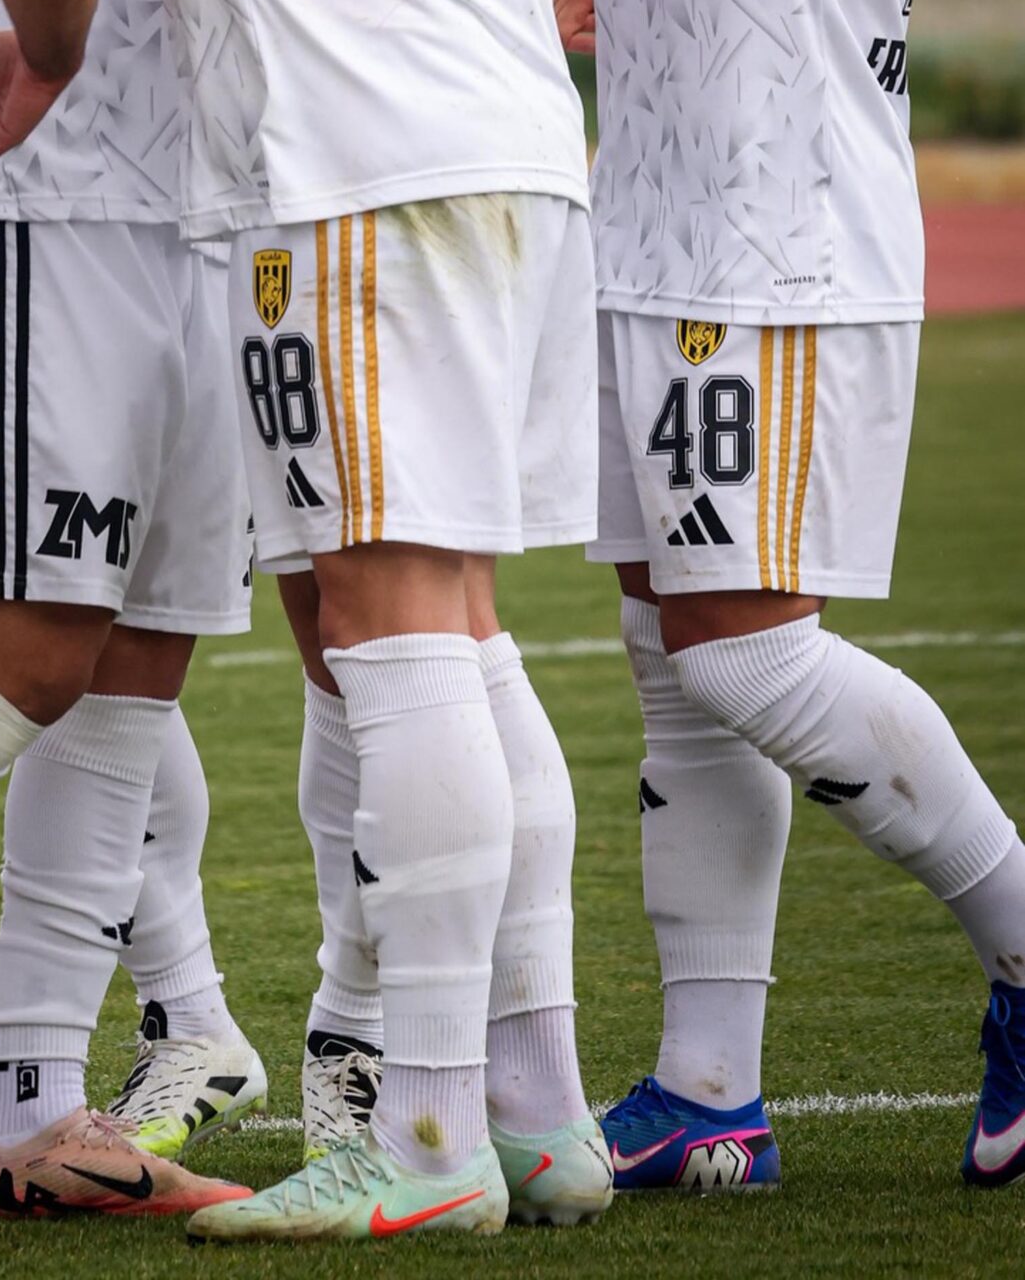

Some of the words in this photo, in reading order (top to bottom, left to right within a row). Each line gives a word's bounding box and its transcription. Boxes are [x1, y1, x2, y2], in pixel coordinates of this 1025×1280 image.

[240, 332, 321, 450] 88
[647, 375, 754, 489] 48
[35, 489, 138, 570] ZMS
